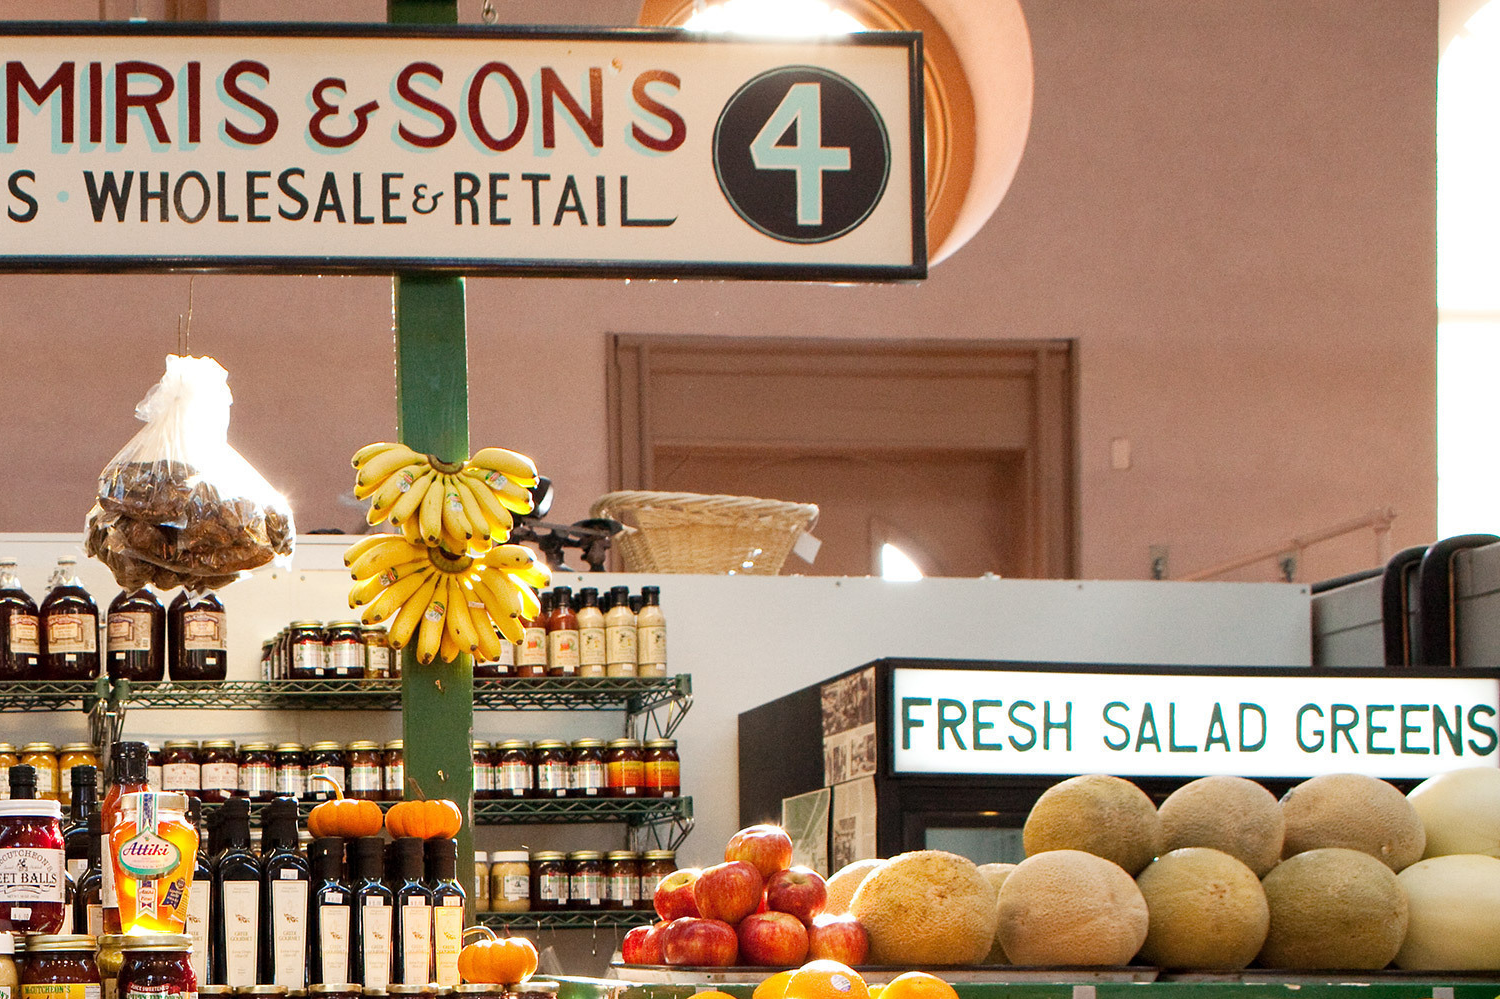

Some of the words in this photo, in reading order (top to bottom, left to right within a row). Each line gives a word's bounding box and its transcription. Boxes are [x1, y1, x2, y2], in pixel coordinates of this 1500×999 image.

[306, 77, 381, 149] &
[393, 58, 687, 153] SON'S
[748, 82, 851, 227] 4
[82, 167, 408, 225] WHOLESALE
[412, 183, 444, 214] &
[453, 172, 679, 228] RETAIL
[901, 697, 1073, 752] FRESH
[1103, 701, 1268, 753] SALAD
[1295, 703, 1498, 757] GREENS
[21, 872, 57, 884] BALLS
[122, 841, 169, 856] Attiki
